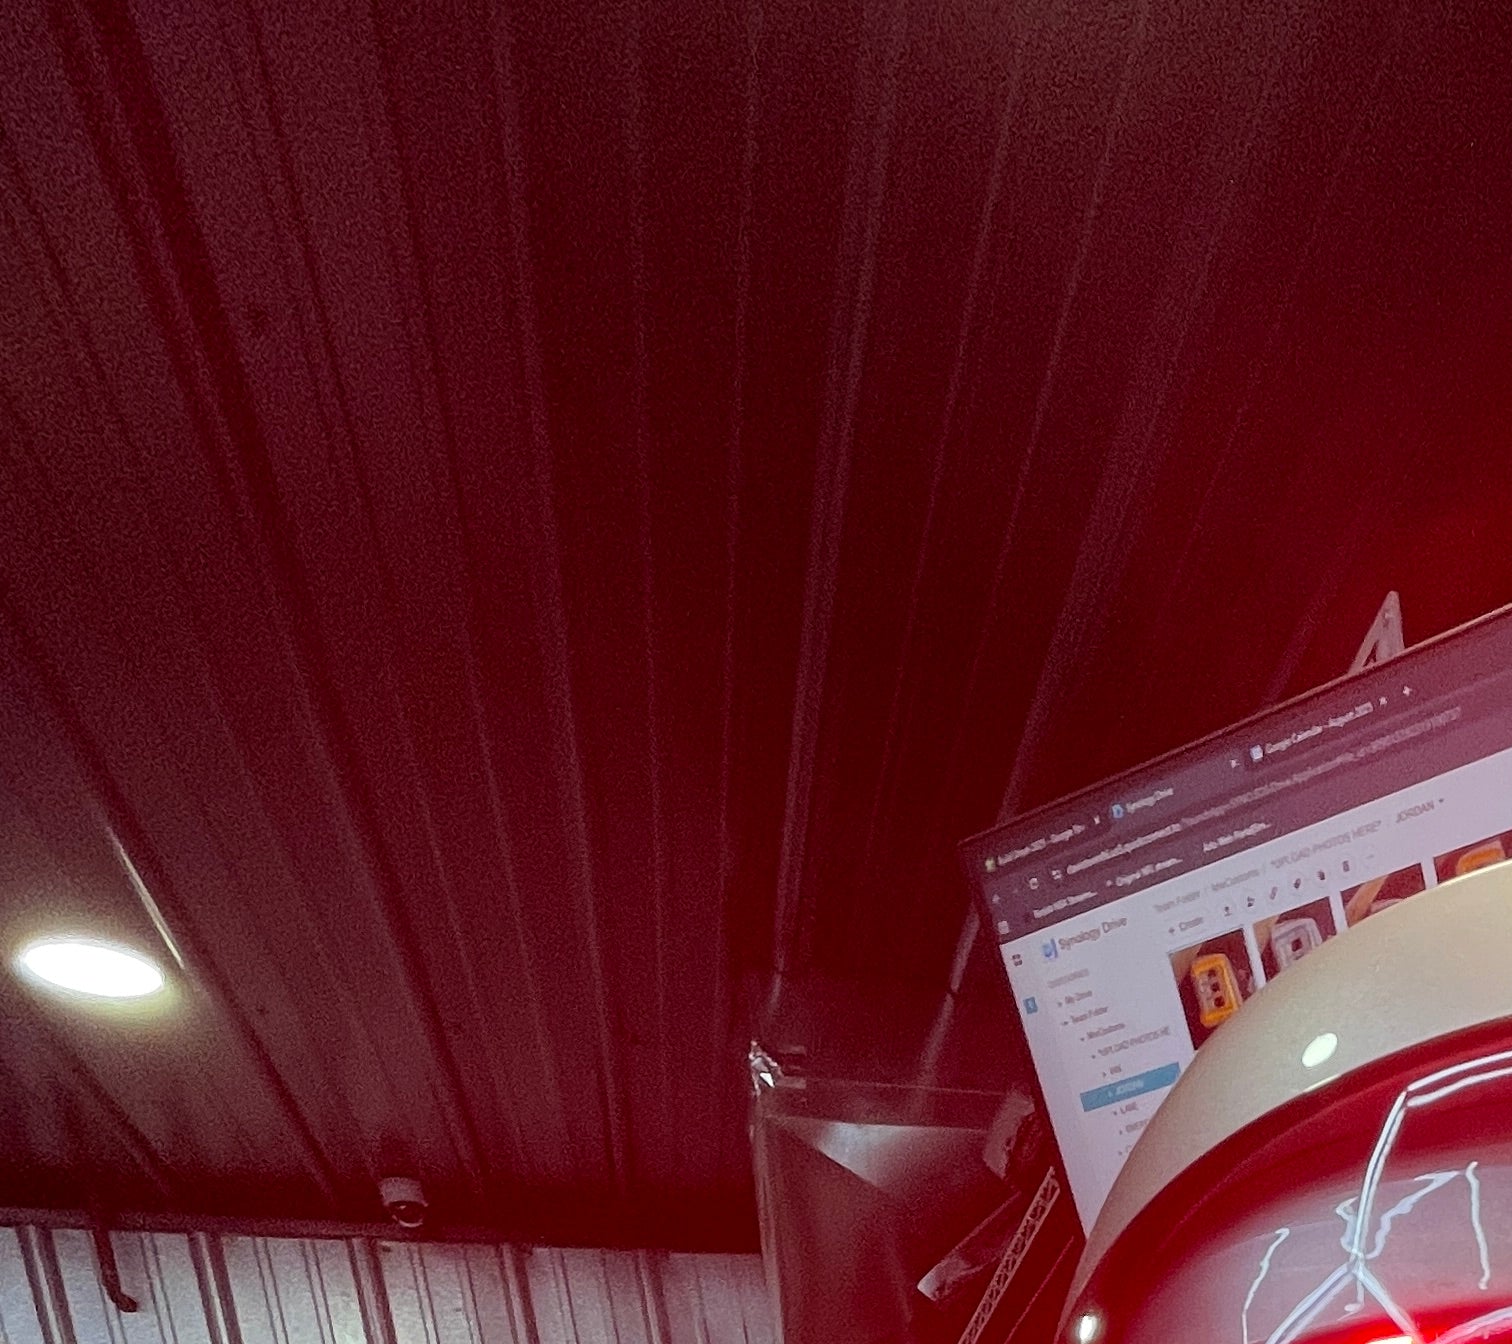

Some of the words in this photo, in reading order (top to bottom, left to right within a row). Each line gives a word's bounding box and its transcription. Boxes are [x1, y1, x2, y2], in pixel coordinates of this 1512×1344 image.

[1396, 801, 1435, 823] JORDAN
[1058, 928, 1101, 950] Synology
[1101, 917, 1127, 934] Drive
